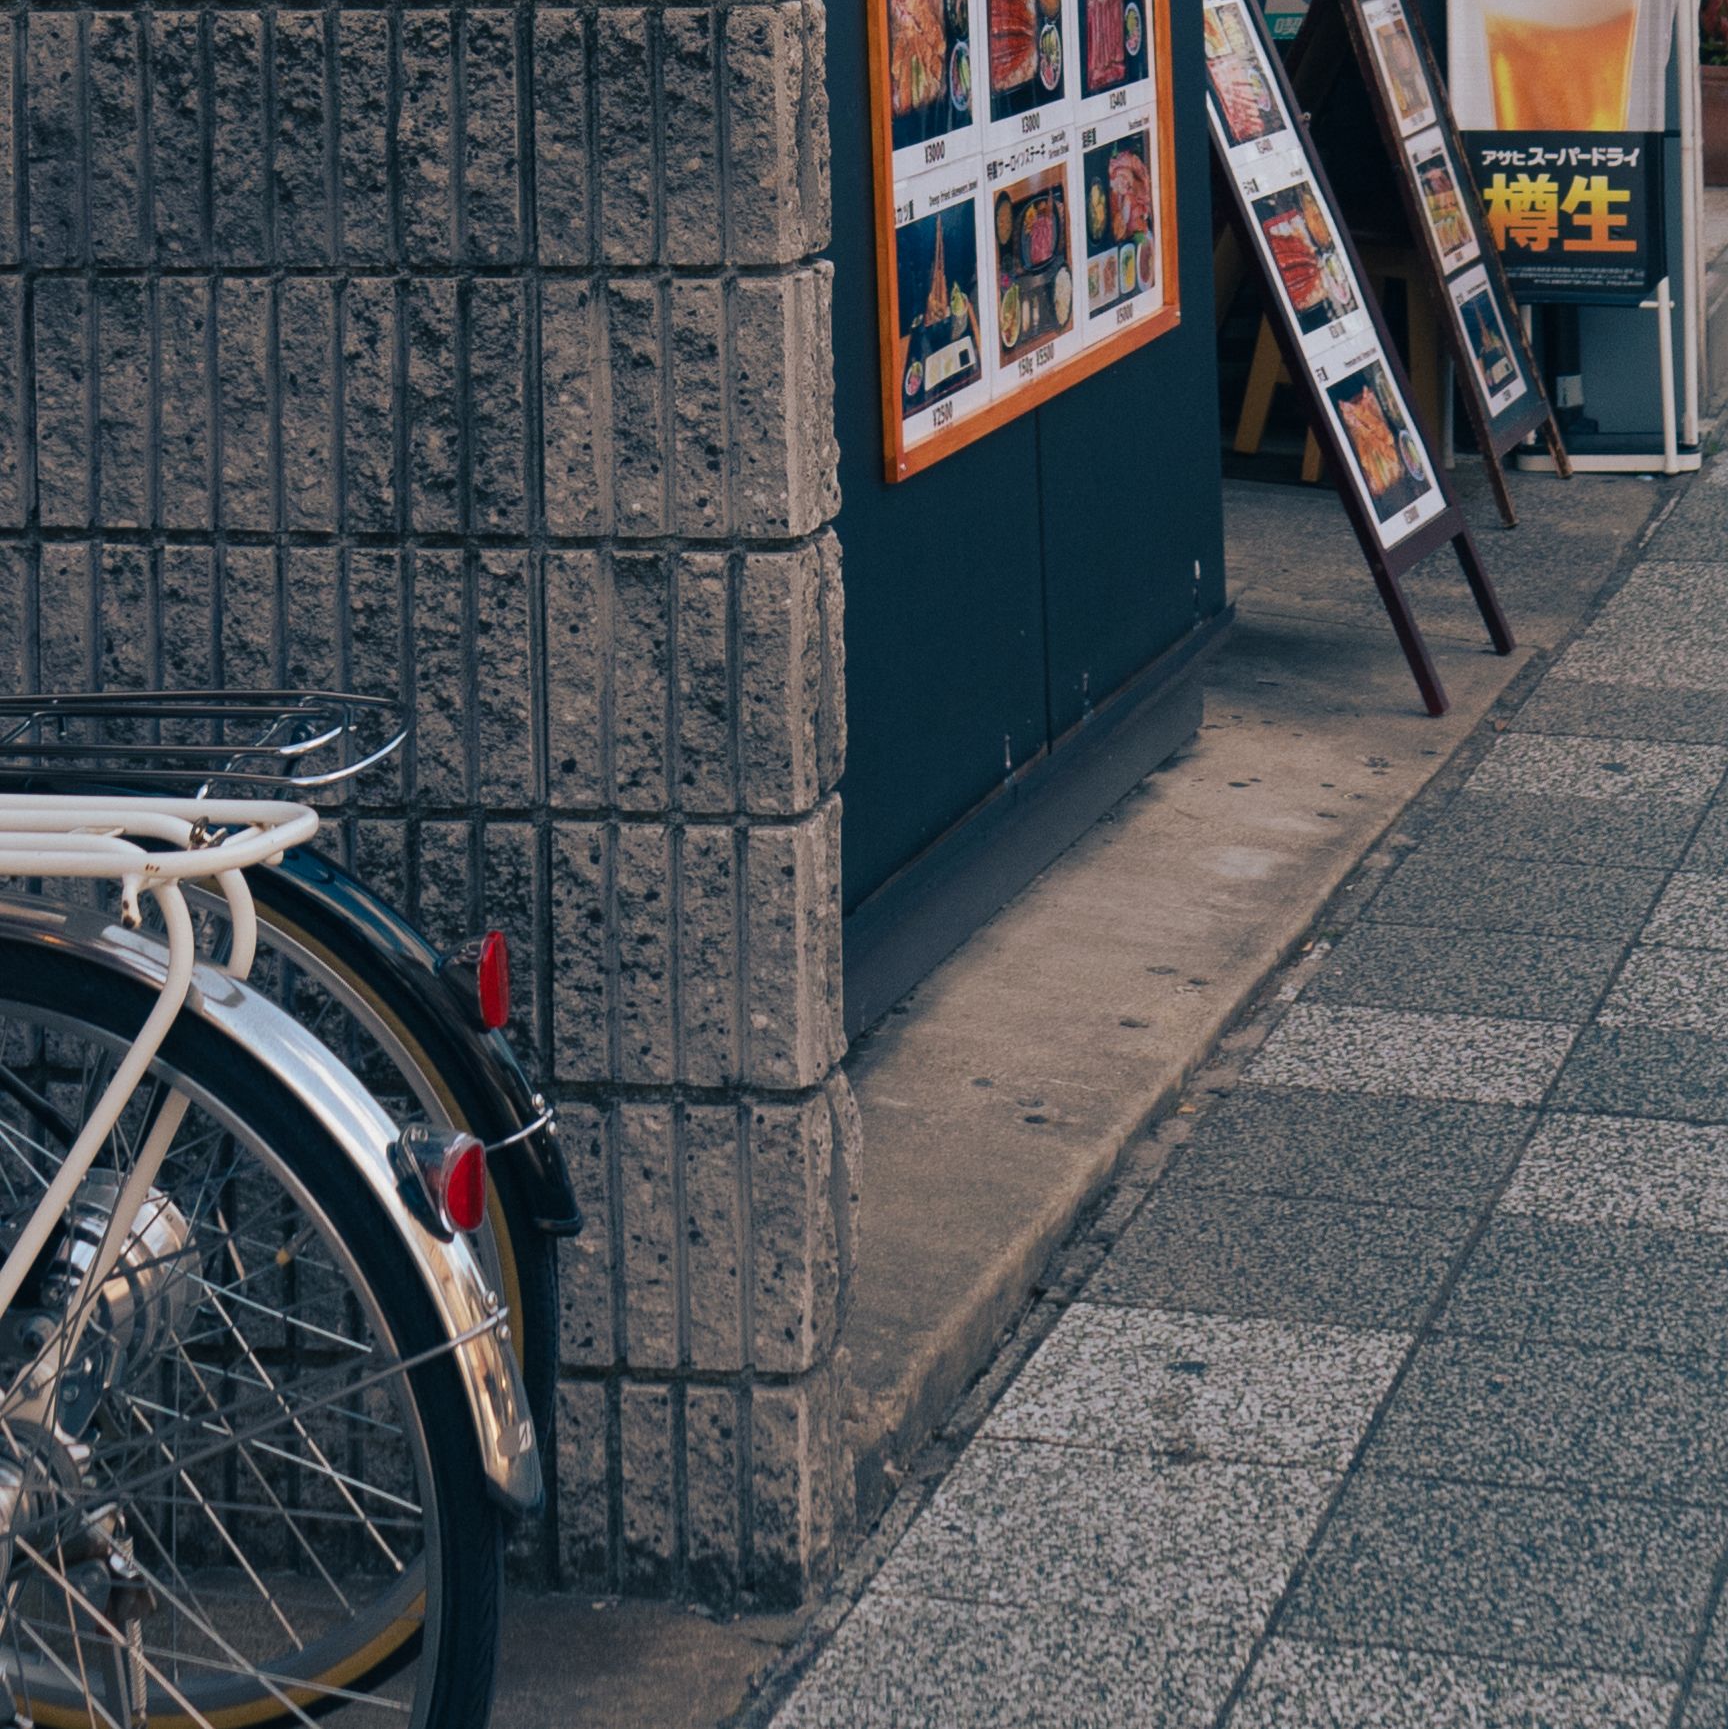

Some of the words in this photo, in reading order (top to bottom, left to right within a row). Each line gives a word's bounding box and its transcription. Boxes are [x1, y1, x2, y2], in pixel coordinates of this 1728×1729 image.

[925, 140, 945, 164] ¥3000
[1481, 147, 1640, 169] アサヒスーパードライ
[1483, 172, 1637, 253] 樽生
[932, 400, 952, 427] ¥2500
